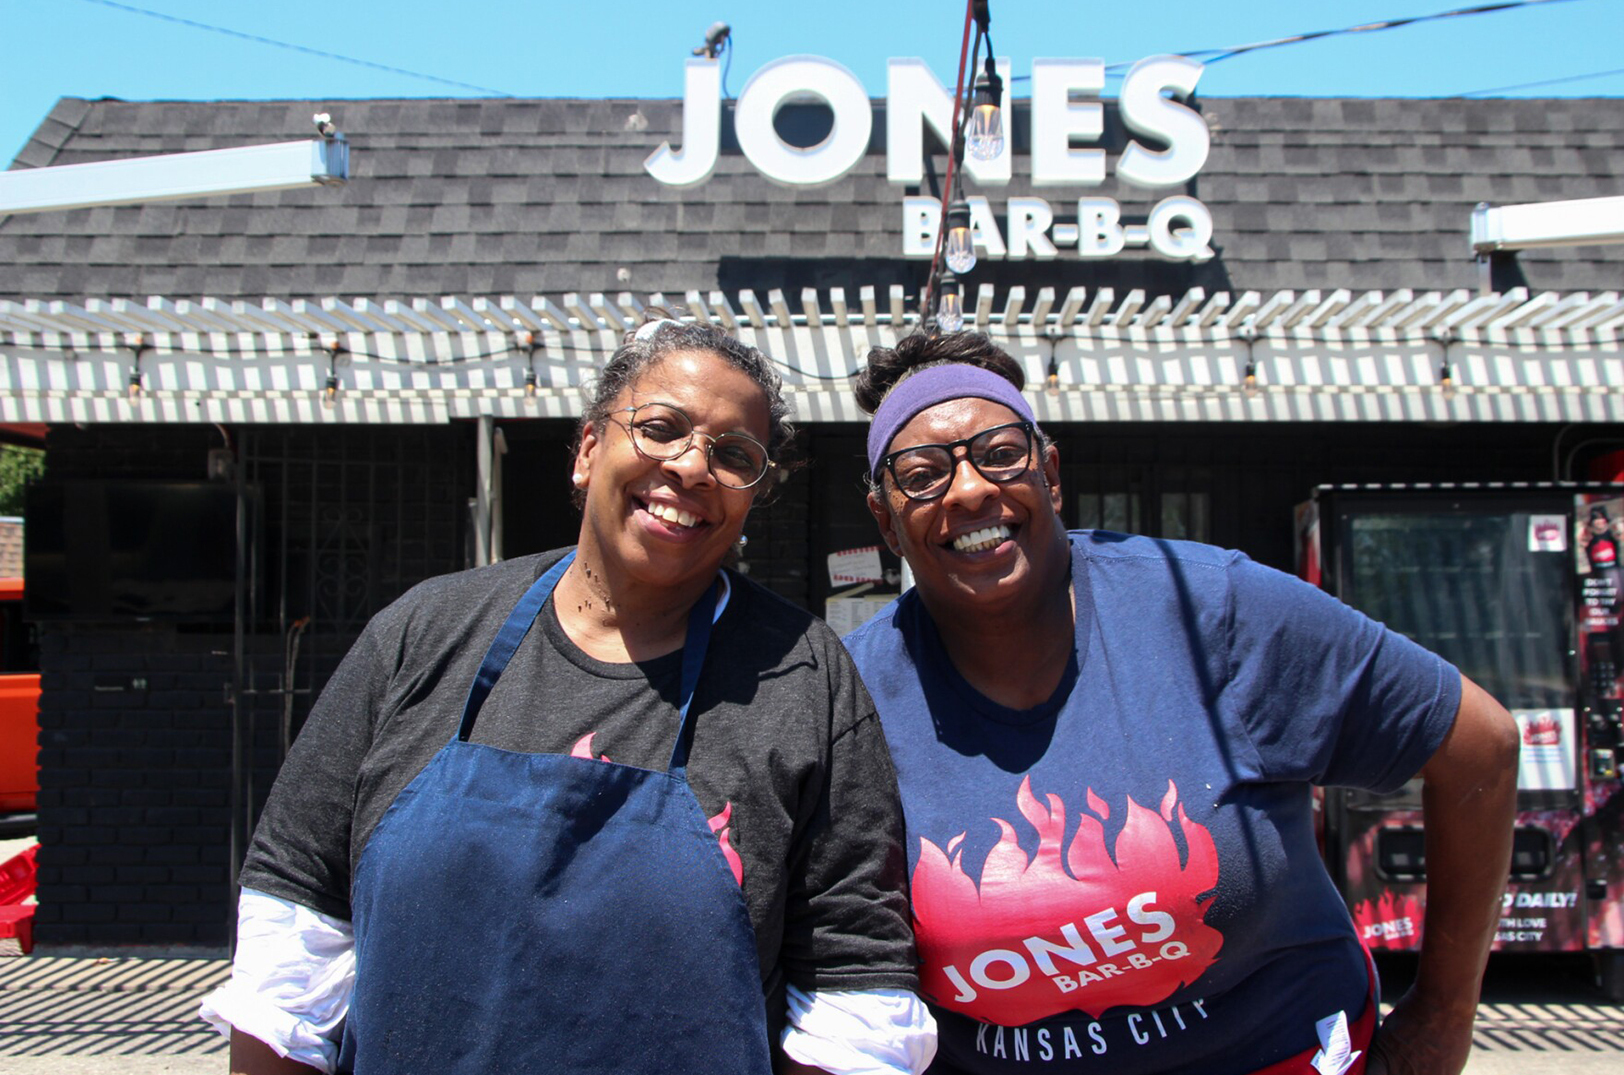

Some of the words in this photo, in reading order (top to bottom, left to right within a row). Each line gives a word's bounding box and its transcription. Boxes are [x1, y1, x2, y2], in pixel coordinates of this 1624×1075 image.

[644, 54, 1211, 188] JONES
[903, 195, 1215, 262] BAR-B-Q
[1515, 892, 1578, 908] DAILY!
[1517, 918, 1547, 928] LOVE
[943, 891, 1176, 1003] JONES
[1363, 917, 1413, 939] JONES
[1516, 931, 1543, 942] CITY
[1052, 940, 1191, 994] BAR-B-Q
[976, 1021, 1108, 1062] KANSAS
[1127, 998, 1209, 1046] CITY
